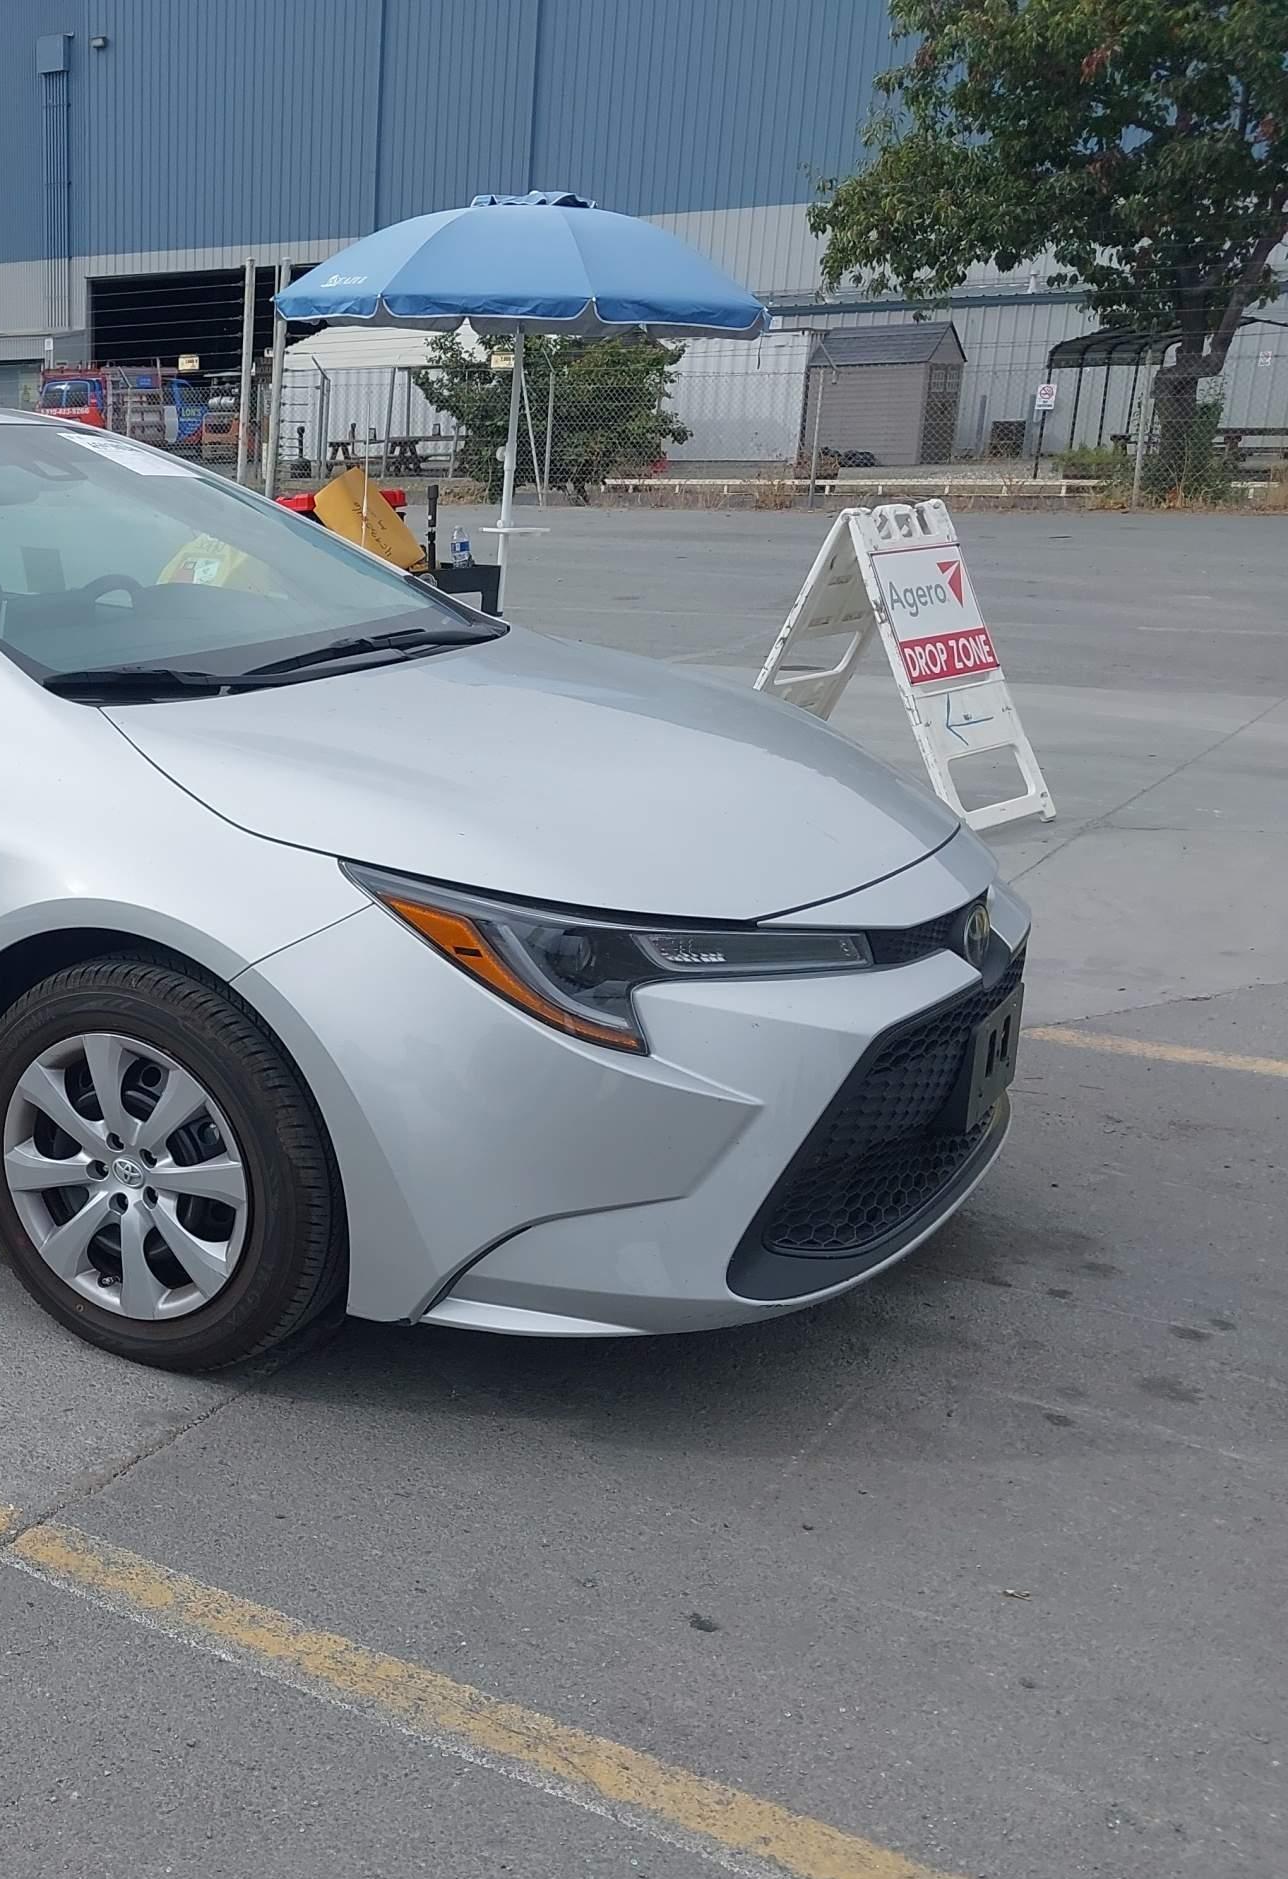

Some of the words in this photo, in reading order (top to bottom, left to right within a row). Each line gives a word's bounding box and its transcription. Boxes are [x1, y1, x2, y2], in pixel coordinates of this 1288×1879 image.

[889, 582, 946, 616] Agero
[904, 642, 948, 677] DROP
[949, 634, 993, 669] ZONE
